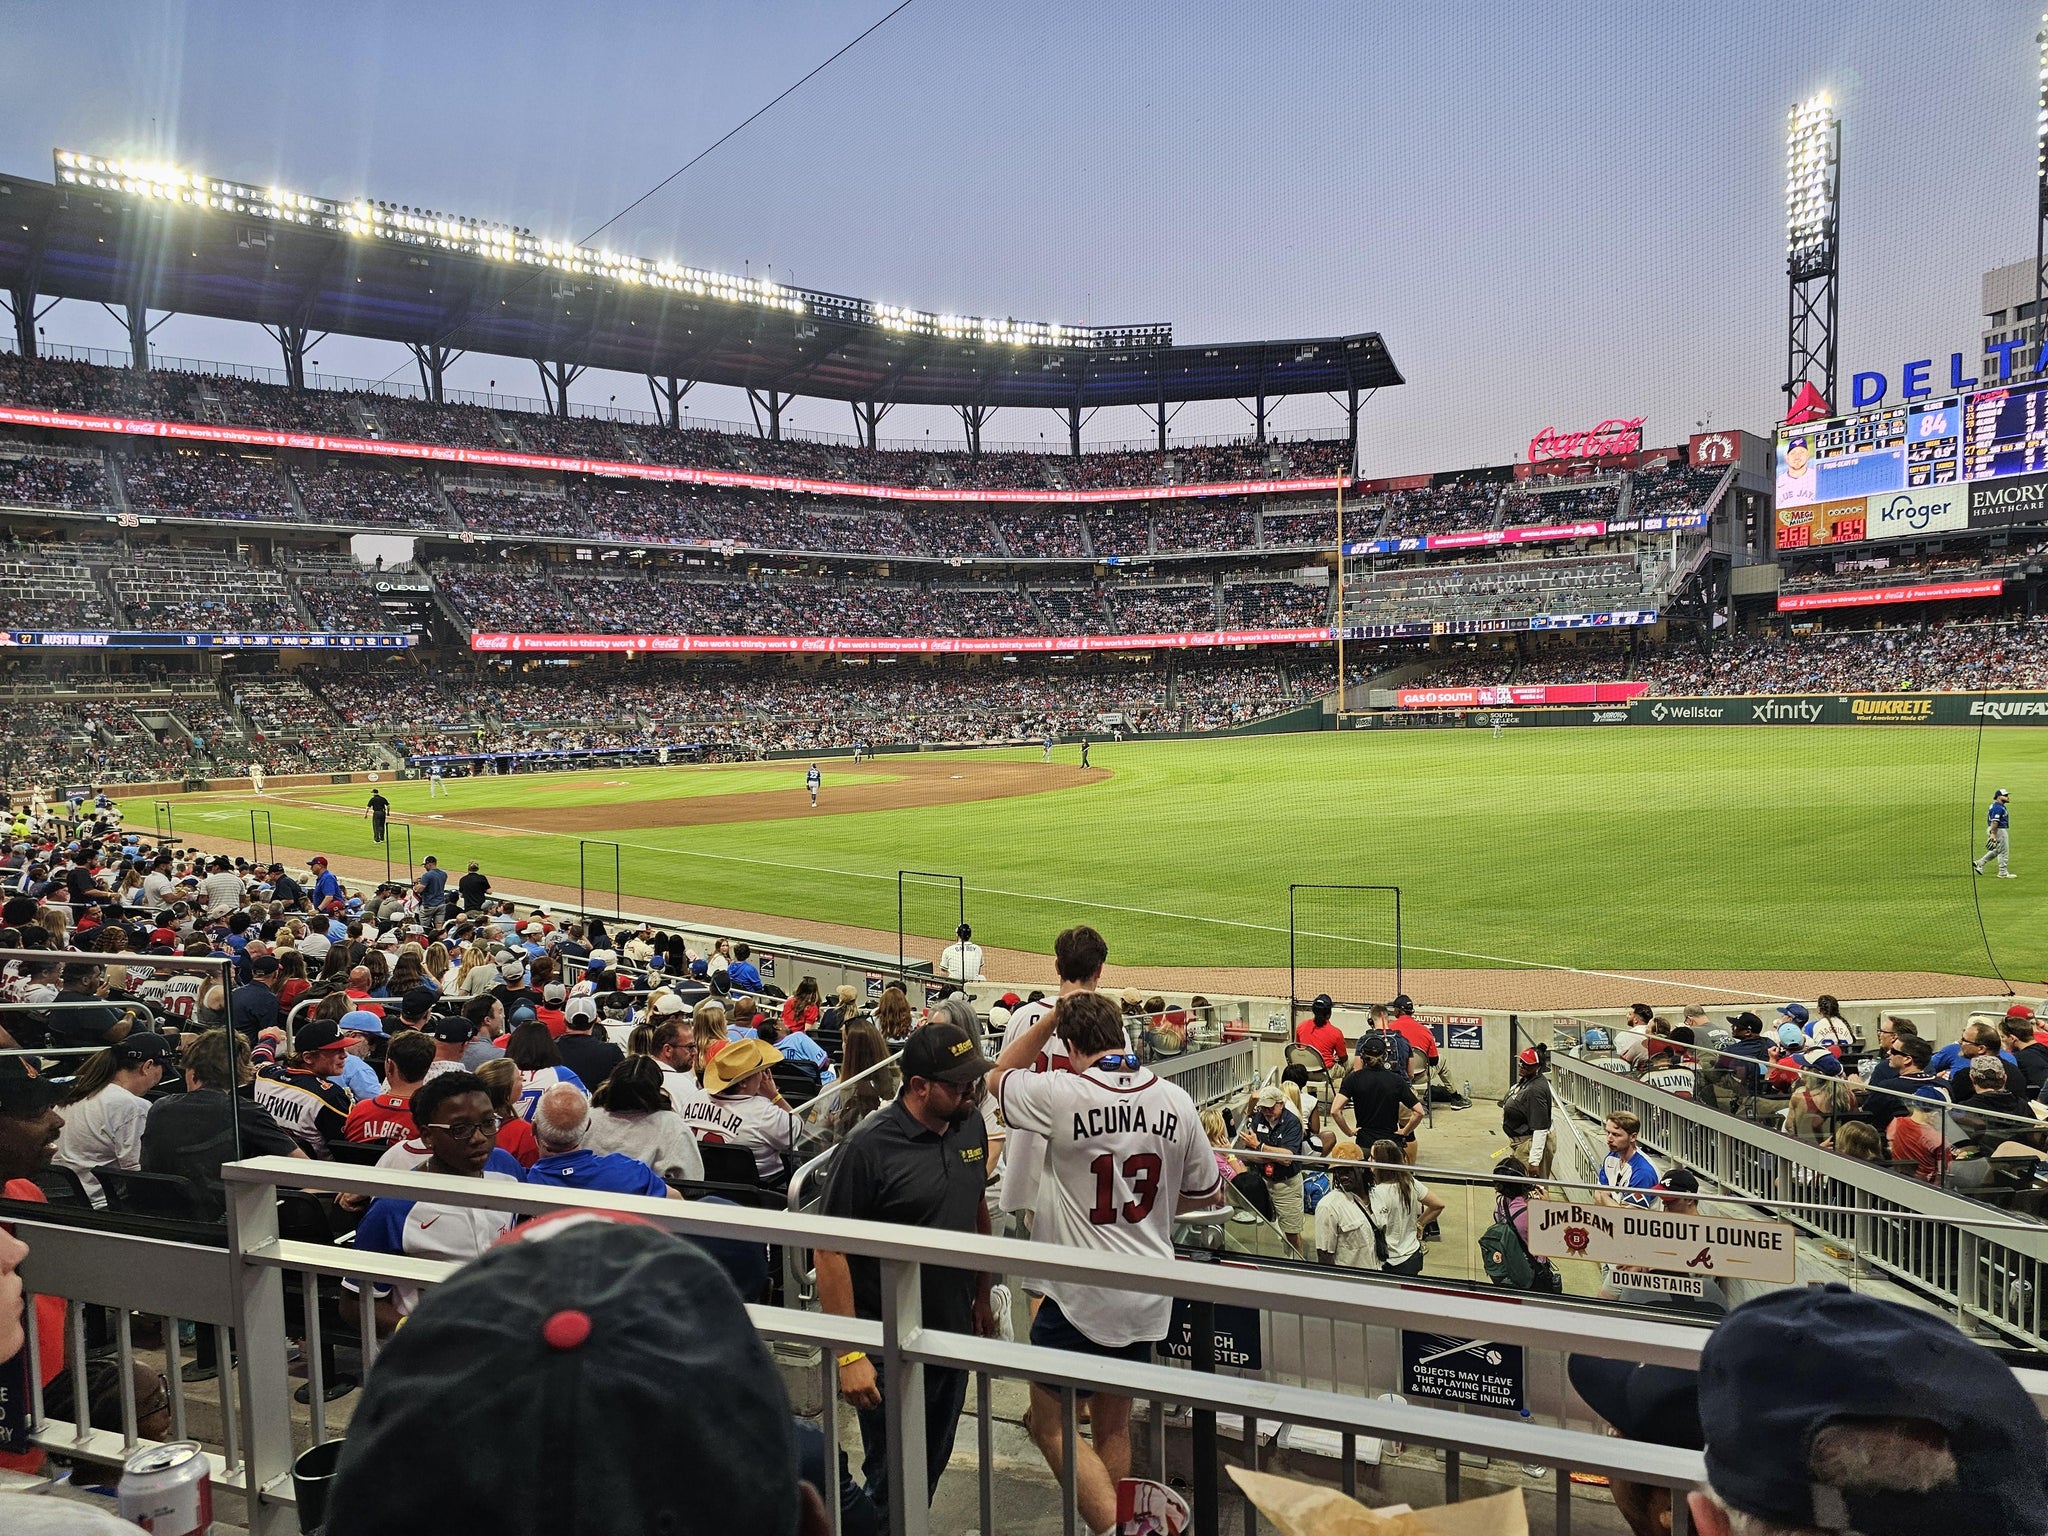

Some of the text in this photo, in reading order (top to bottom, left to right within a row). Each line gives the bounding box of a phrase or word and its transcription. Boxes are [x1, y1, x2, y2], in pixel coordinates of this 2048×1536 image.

[14, 414, 110, 428] work is thirsty work
[1920, 413, 1947, 437] 84
[171, 427, 274, 443] Fan work is thirsty work
[1528, 416, 1648, 463] Coca-Cola
[328, 440, 420, 456] Fan work is thirsty work
[1965, 446, 1976, 455] 27
[467, 453, 480, 462] Fan
[481, 455, 499, 463] work
[507, 456, 531, 467] thirsty
[1913, 474, 1926, 485] 87
[1973, 483, 2047, 508] EMORY
[1881, 496, 1951, 529] Kroger
[1974, 501, 2044, 517] HEALTHCARE
[118, 513, 139, 527] 35
[1666, 515, 1702, 528] $21,371
[1791, 511, 1814, 521] MEGA
[1626, 522, 1639, 531] PM
[1837, 519, 1864, 536] 194
[460, 531, 474, 543] 41
[1778, 526, 1810, 542] 368
[1832, 533, 1863, 543] MILLION
[1779, 540, 1808, 548] MILLION
[721, 545, 734, 557] 44
[1417, 566, 1624, 596] HANK AARON TERRACE
[391, 584, 430, 592] LEXUS
[1951, 587, 1973, 596] thirsty
[1838, 595, 1857, 604] thirsty
[1625, 616, 1639, 626] 89
[21, 634, 32, 644] 27
[41, 634, 110, 646] AUSTIN RILEY
[186, 636, 197, 645] 3B
[1091, 637, 1177, 649] Fan work is thirsty work
[1227, 631, 1318, 643] Fan work is thirsty work
[525, 638, 635, 650] Fan work is thirsty work
[694, 640, 788, 651] Fan work is thirsty work
[837, 641, 918, 651] Fan work is thirsty work
[962, 641, 1043, 652] Fan work is thirsty work
[1404, 692, 1473, 703] GAS SOUTH
[1480, 692, 1494, 700] AL
[1670, 705, 1723, 719] Wellstar
[1752, 699, 1823, 722] xfinity
[1412, 1014, 1443, 1023] CAUTION
[1819, 1026, 1849, 1038] HARRIS II
[722, 1113, 743, 1136] JR.
[1073, 1099, 1178, 1144] ACUÑA JR.
[363, 1120, 411, 1142] ALBIES
[1089, 1153, 1163, 1226] 13
[1539, 1205, 1783, 1251] JIM BEAM DUGOUT LOUNGE
[1612, 1271, 1702, 1295] DOWNSTAIRS
[1182, 1330, 1234, 1350] WCH
[1214, 1349, 1250, 1365] STEP
[1413, 1364, 1513, 1387] OBJECTS MAY LEAVE
[1415, 1374, 1511, 1396] THE PLAYING FIELD
[1411, 1383, 1516, 1406] & MAY CAUSE INJURY
